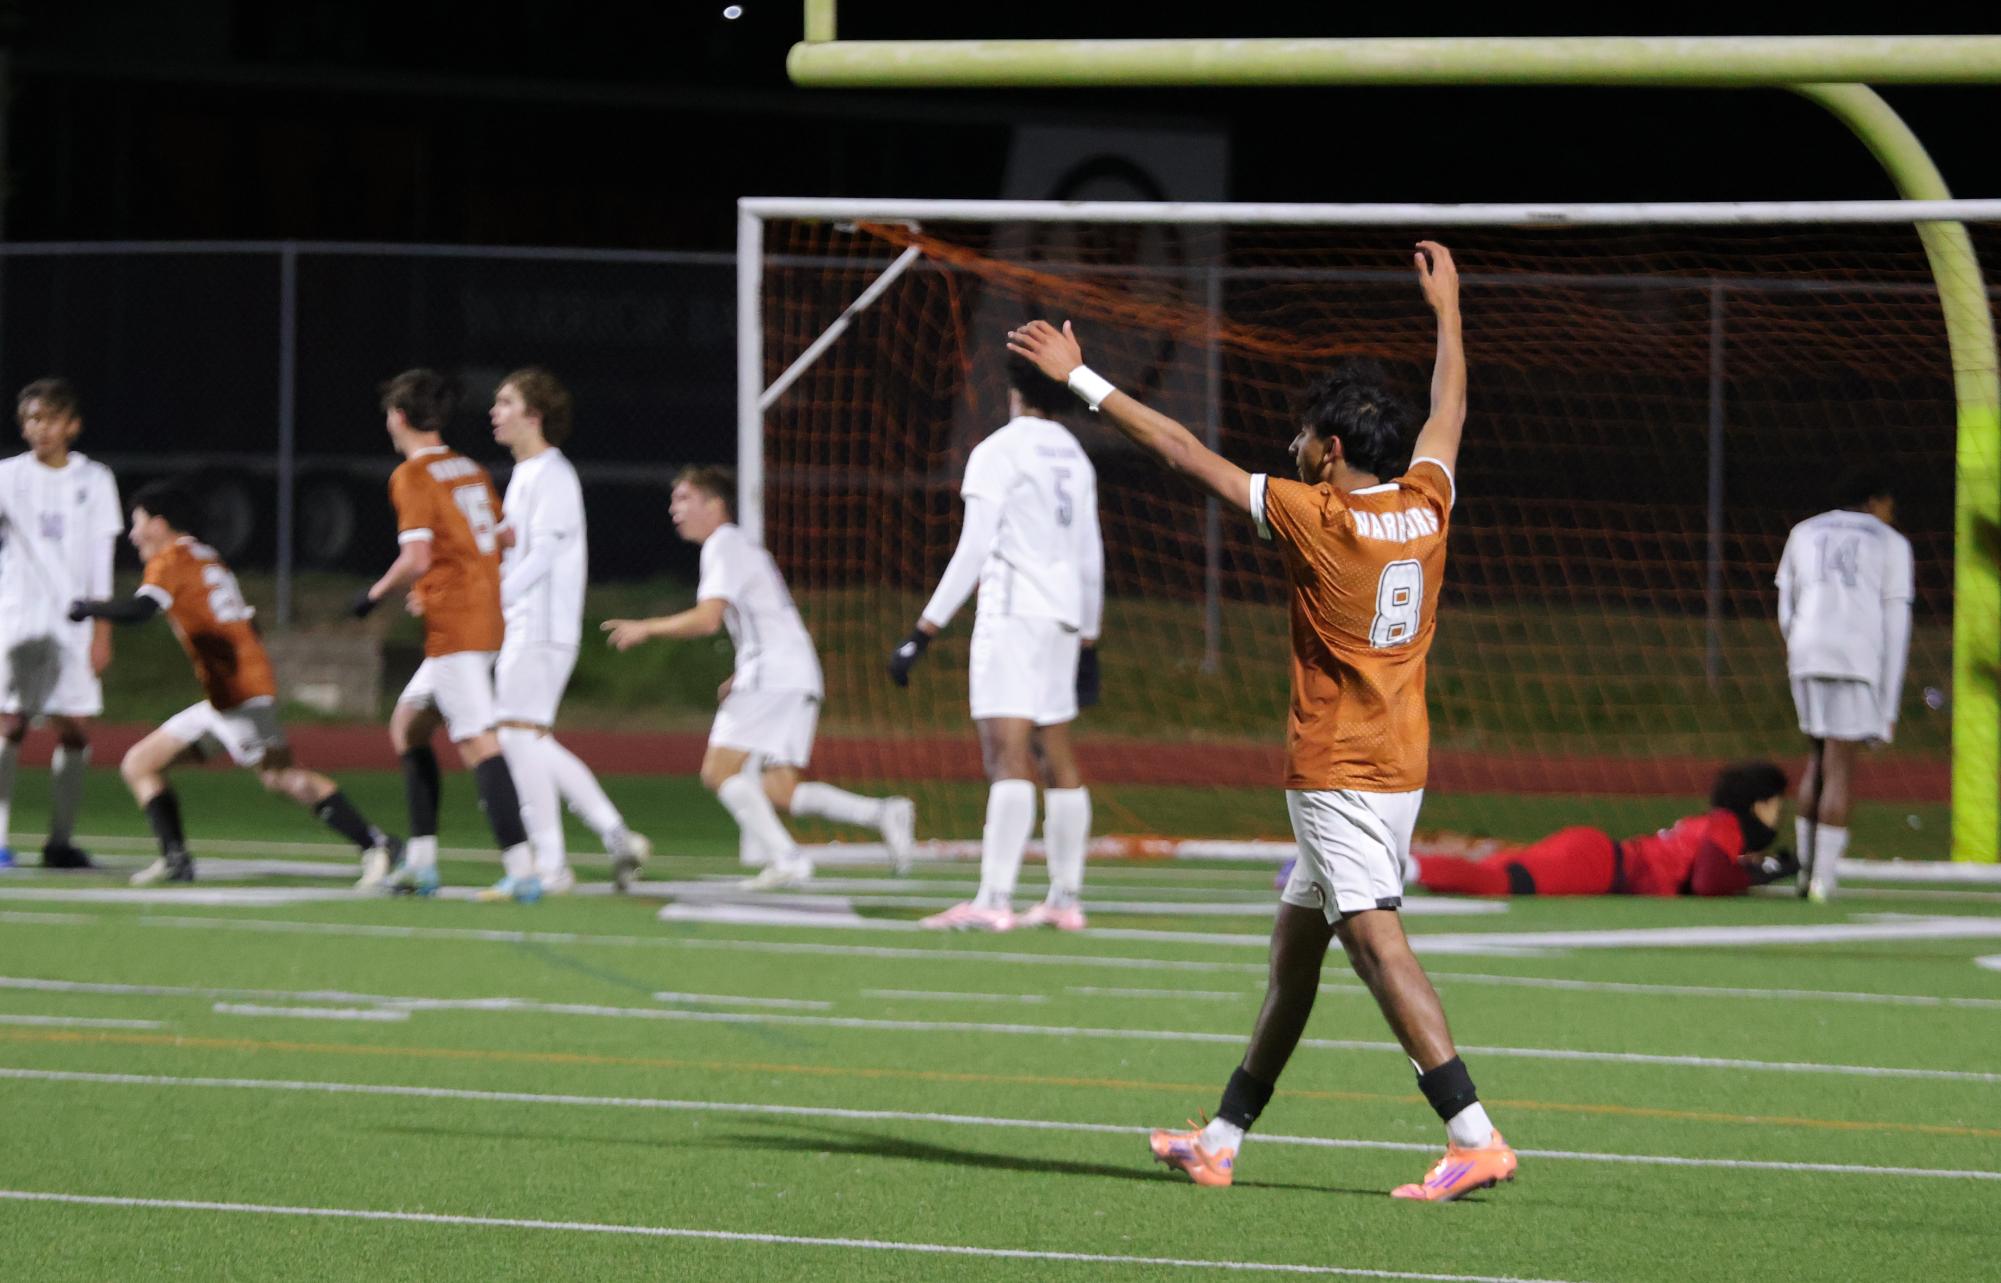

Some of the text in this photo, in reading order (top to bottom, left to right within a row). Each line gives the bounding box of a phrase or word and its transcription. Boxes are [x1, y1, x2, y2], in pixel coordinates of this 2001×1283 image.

[1052, 466, 1073, 529] 5
[1349, 508, 1439, 543] WARRORS
[1369, 559, 1423, 648] 8
